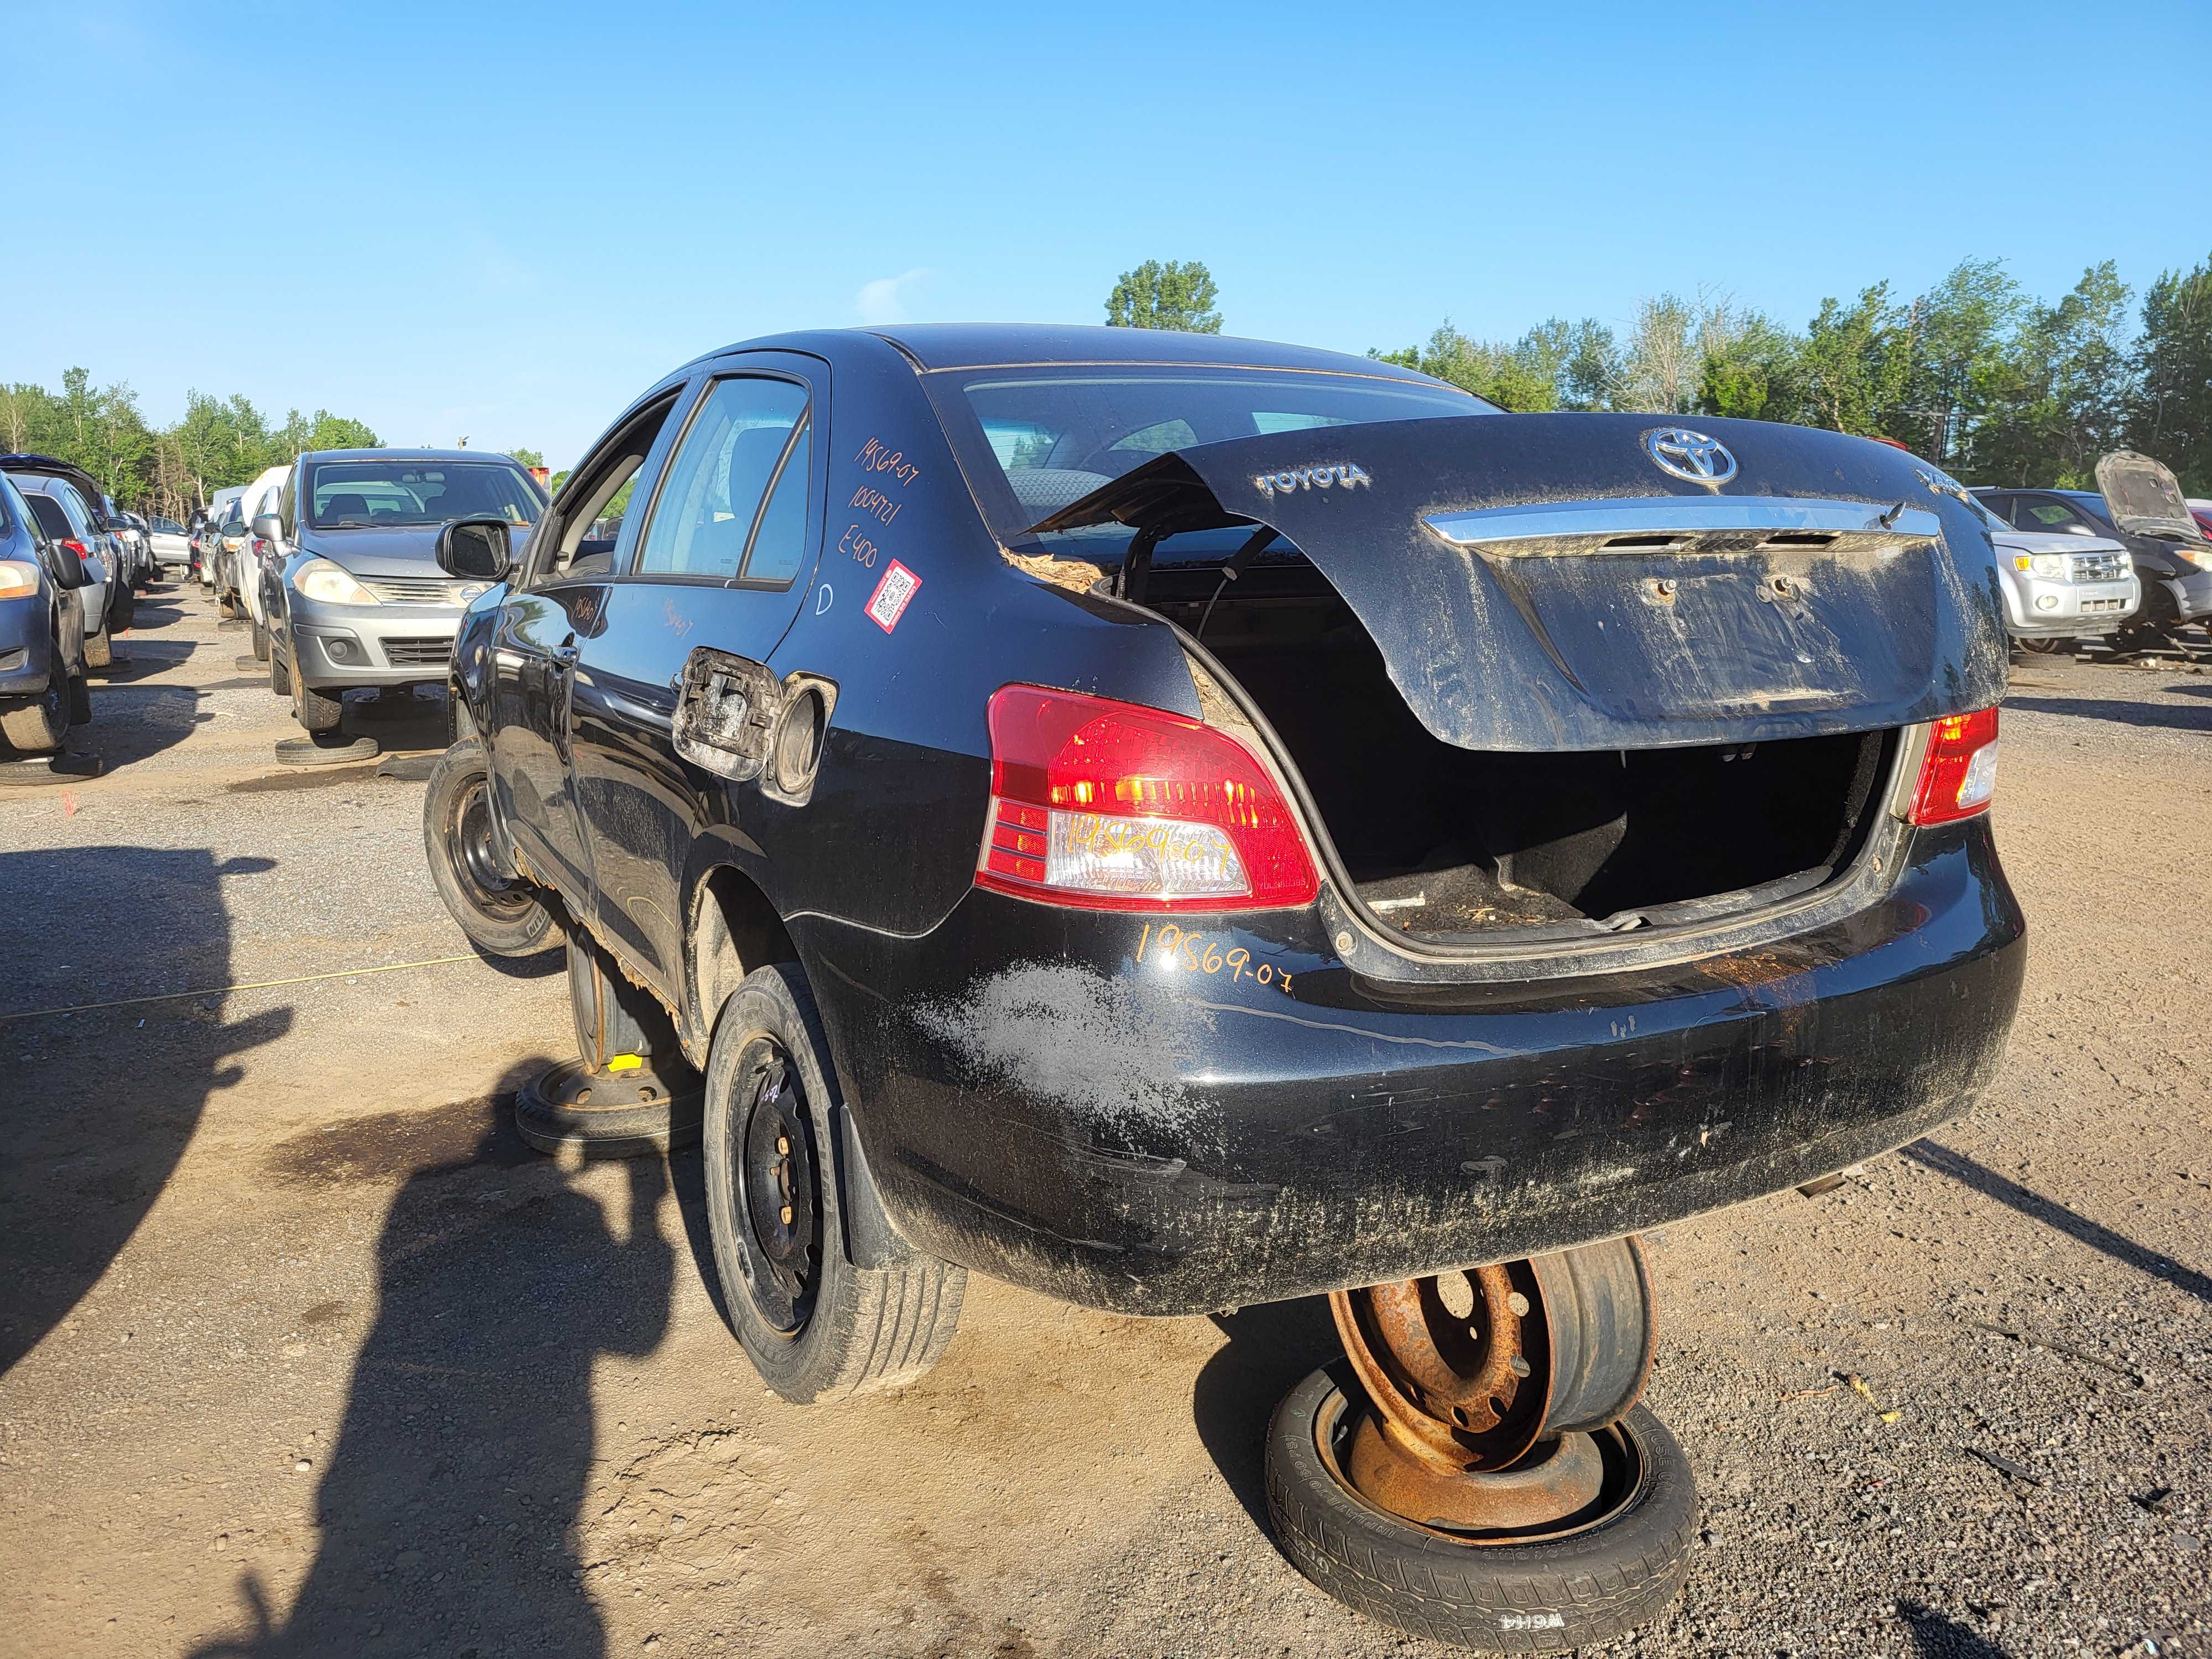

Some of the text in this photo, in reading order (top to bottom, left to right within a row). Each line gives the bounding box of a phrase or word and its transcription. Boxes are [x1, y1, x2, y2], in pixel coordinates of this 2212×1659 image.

[1255, 463, 1371, 498] TOYOTA
[838, 524, 878, 568] E400
[1136, 922, 1293, 993] 19569-07
[1308, 1480, 1328, 1496] TO
[1327, 1494, 1397, 1538] INFLATE
